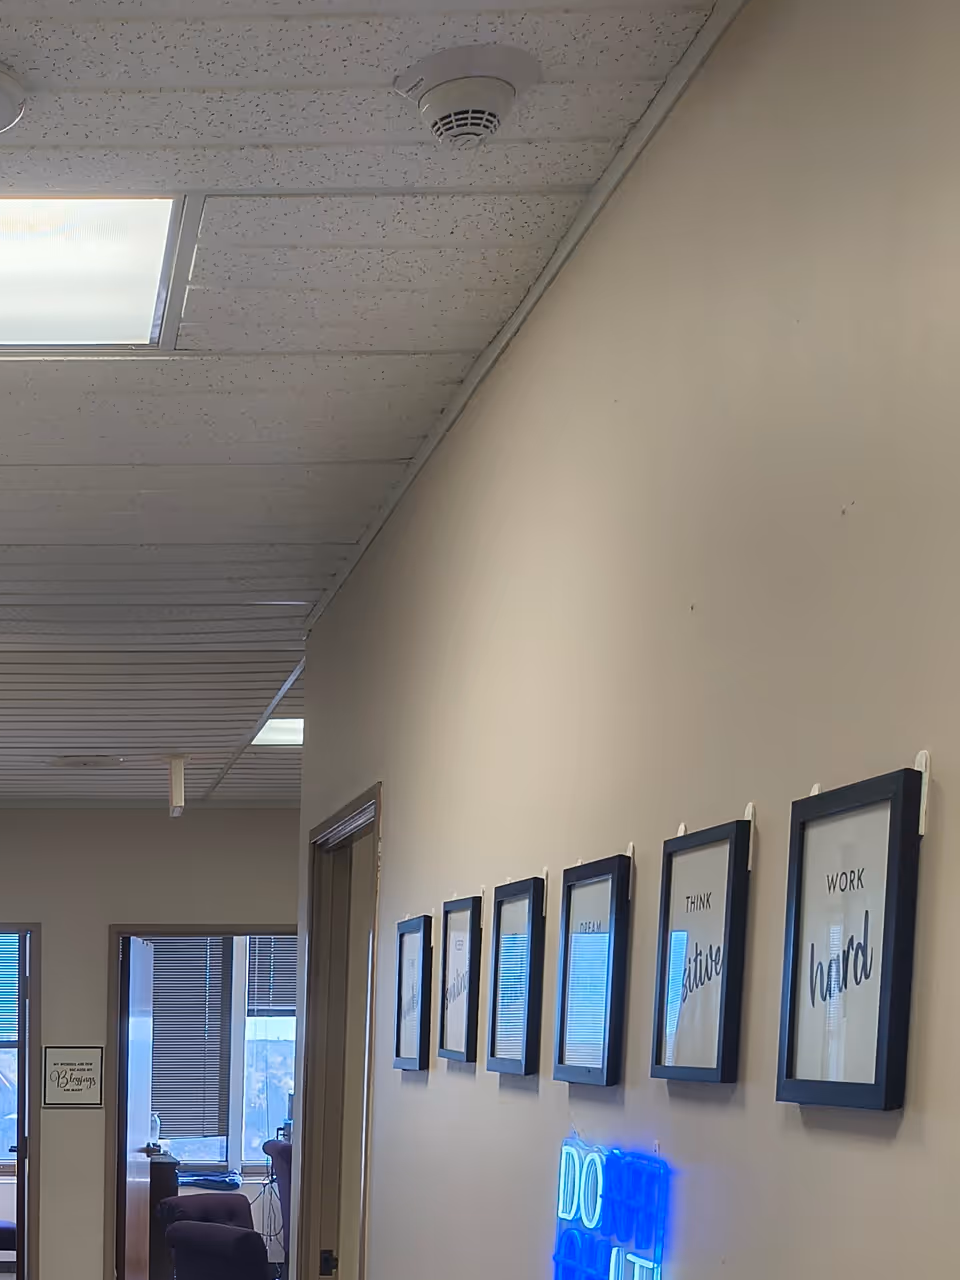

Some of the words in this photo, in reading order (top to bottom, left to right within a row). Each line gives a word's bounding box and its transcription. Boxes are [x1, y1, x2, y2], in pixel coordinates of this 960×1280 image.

[826, 867, 866, 895] WORK
[685, 892, 713, 913] THINK
[809, 909, 874, 1008] hard
